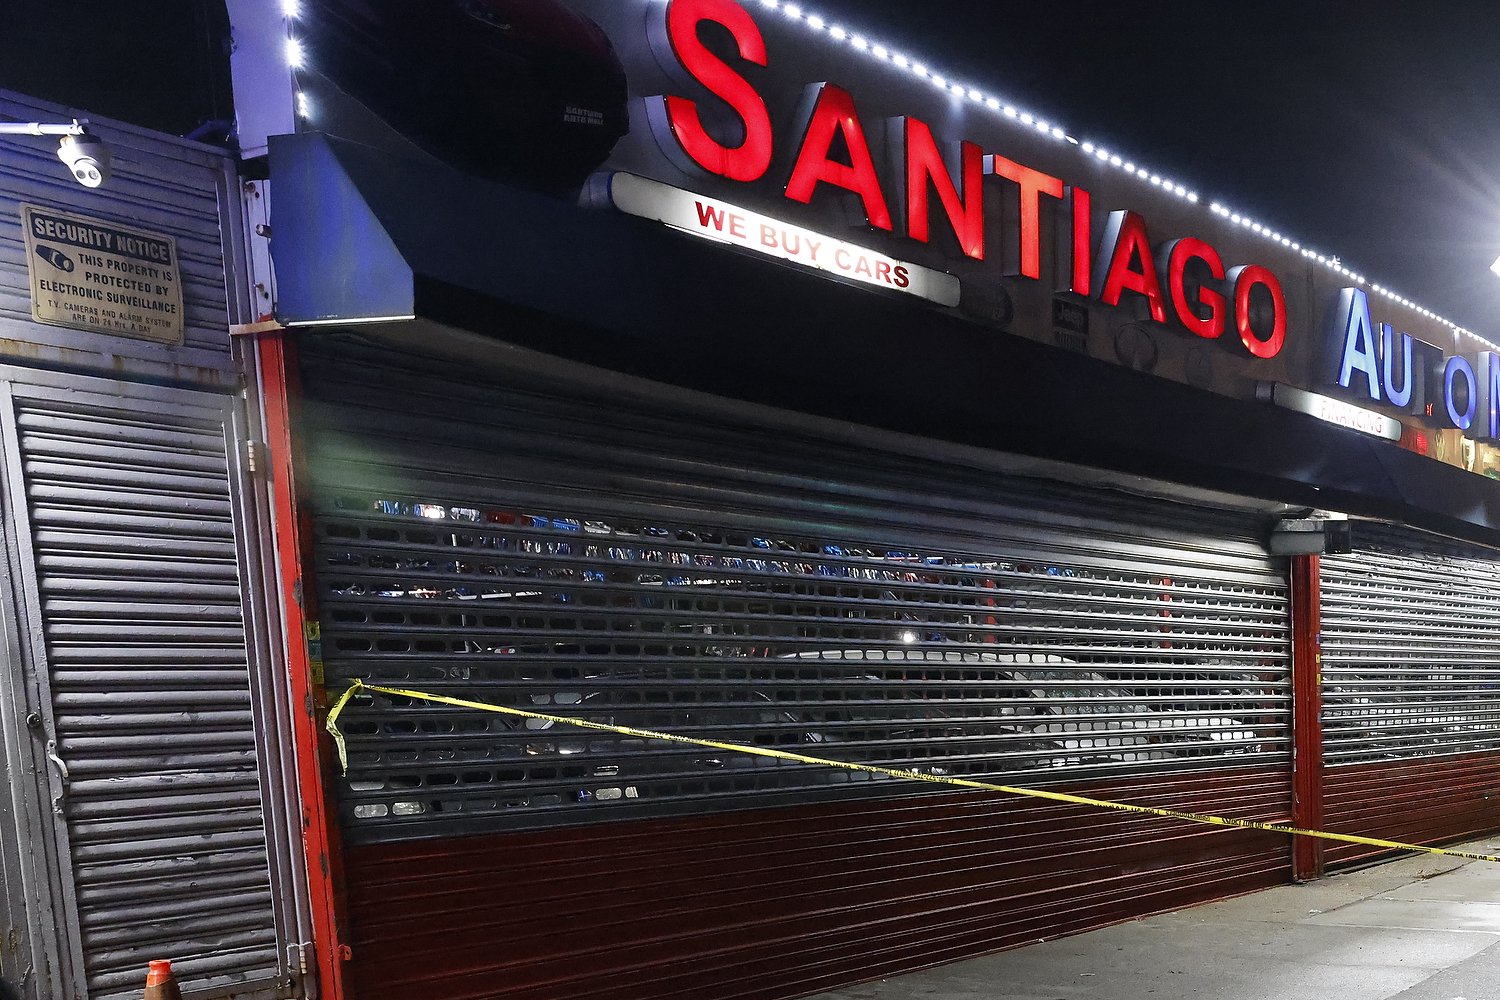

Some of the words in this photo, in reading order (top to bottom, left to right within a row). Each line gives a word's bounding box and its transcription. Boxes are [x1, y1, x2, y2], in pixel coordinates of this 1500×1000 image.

[660, 0, 1287, 358] SANTIAGO
[34, 217, 112, 248] SECURITY
[116, 235, 168, 261] NOTICE
[695, 201, 747, 239] WE
[759, 223, 822, 262] BUY
[834, 248, 909, 288] CARS
[78, 253, 104, 267] THIS
[107, 259, 159, 278] PROPERTY
[162, 270, 173, 281] IS
[40, 279, 103, 301] ELECTRONIC
[106, 291, 176, 314] SURVEILLANCE
[85, 271, 151, 293] PROTECTED
[156, 285, 169, 296] BY
[63, 302, 98, 316] CAMERAS
[101, 309, 116, 319] AND
[119, 312, 143, 323] ALARM
[145, 316, 171, 328] SYSTEM
[72, 313, 87, 322] ARE
[89, 315, 100, 325] ON
[102, 318, 111, 327] 24
[139, 324, 151, 332] DAY
